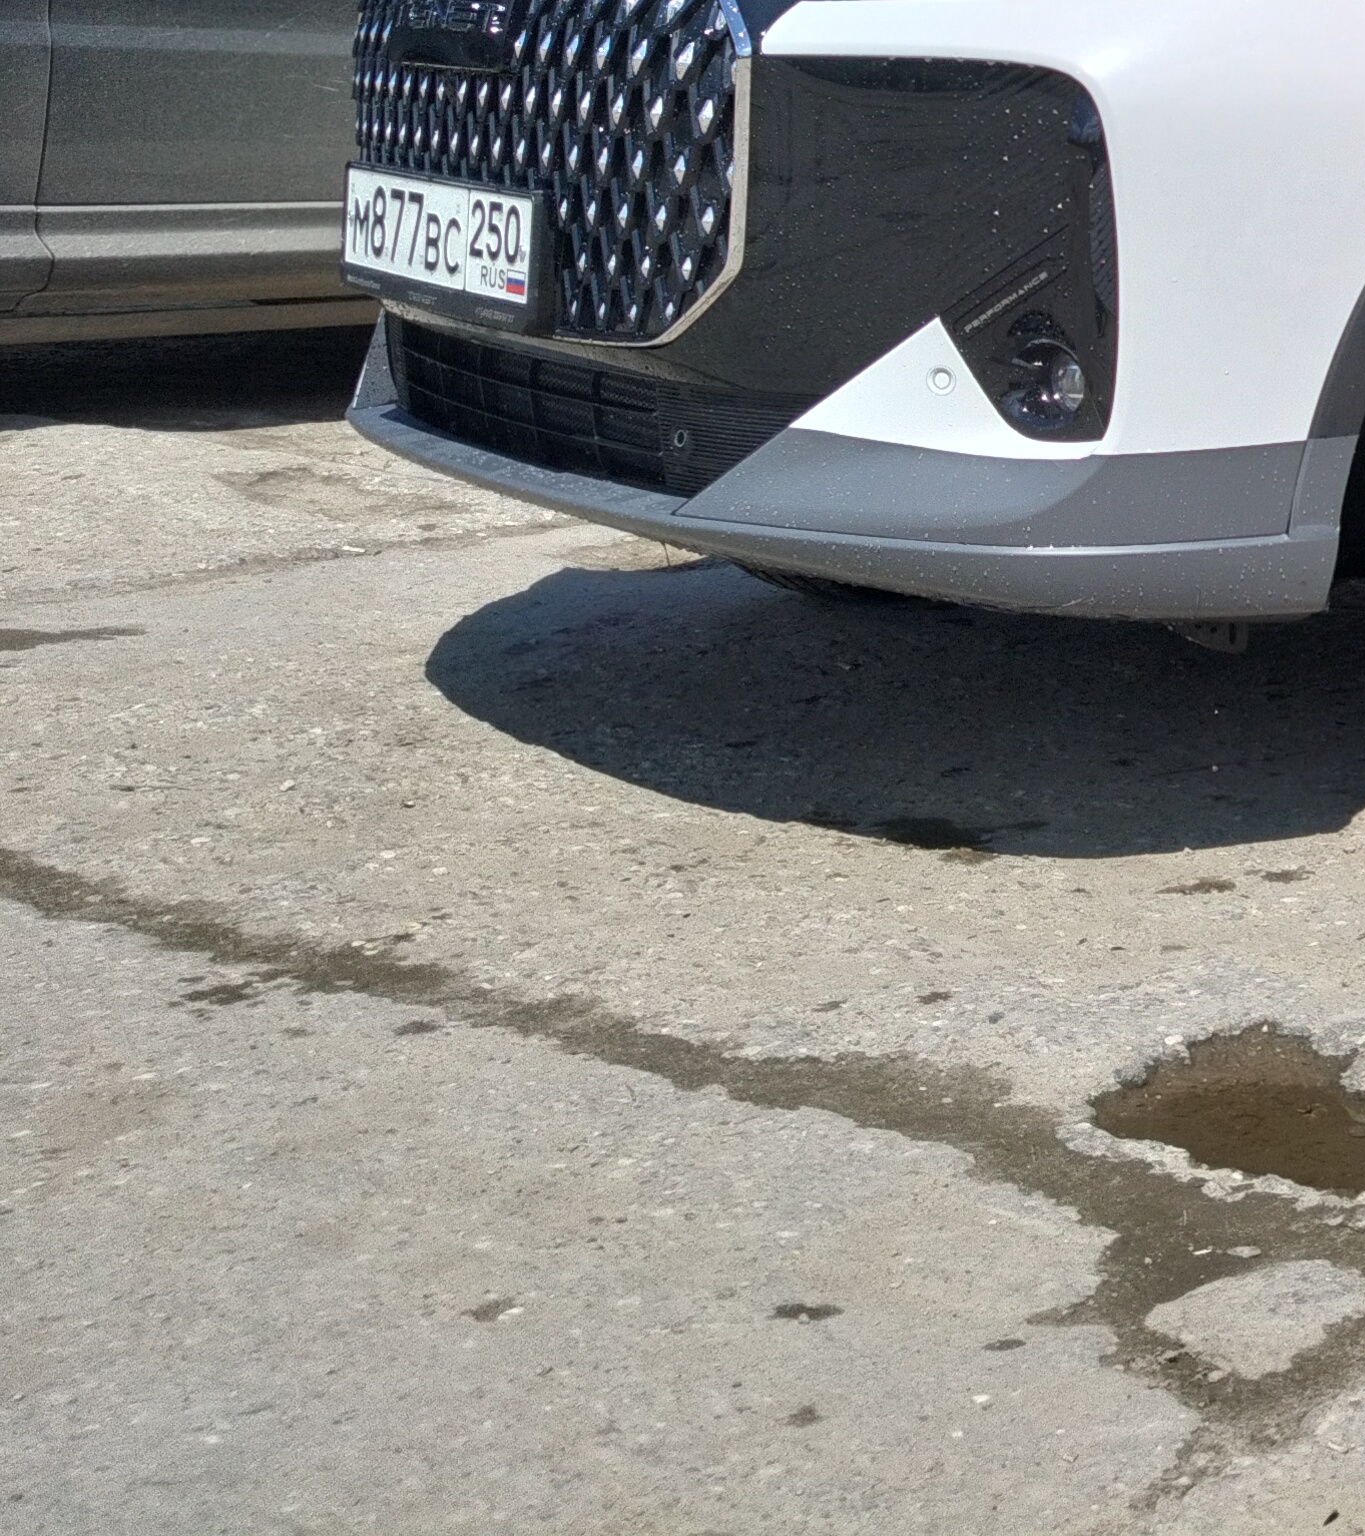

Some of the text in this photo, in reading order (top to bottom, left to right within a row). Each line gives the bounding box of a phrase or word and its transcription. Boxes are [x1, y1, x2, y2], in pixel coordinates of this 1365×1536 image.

[352, 185, 522, 275] М877ВС 250
[480, 265, 506, 290] RUS
[964, 271, 1048, 333] PERFORMANCE
